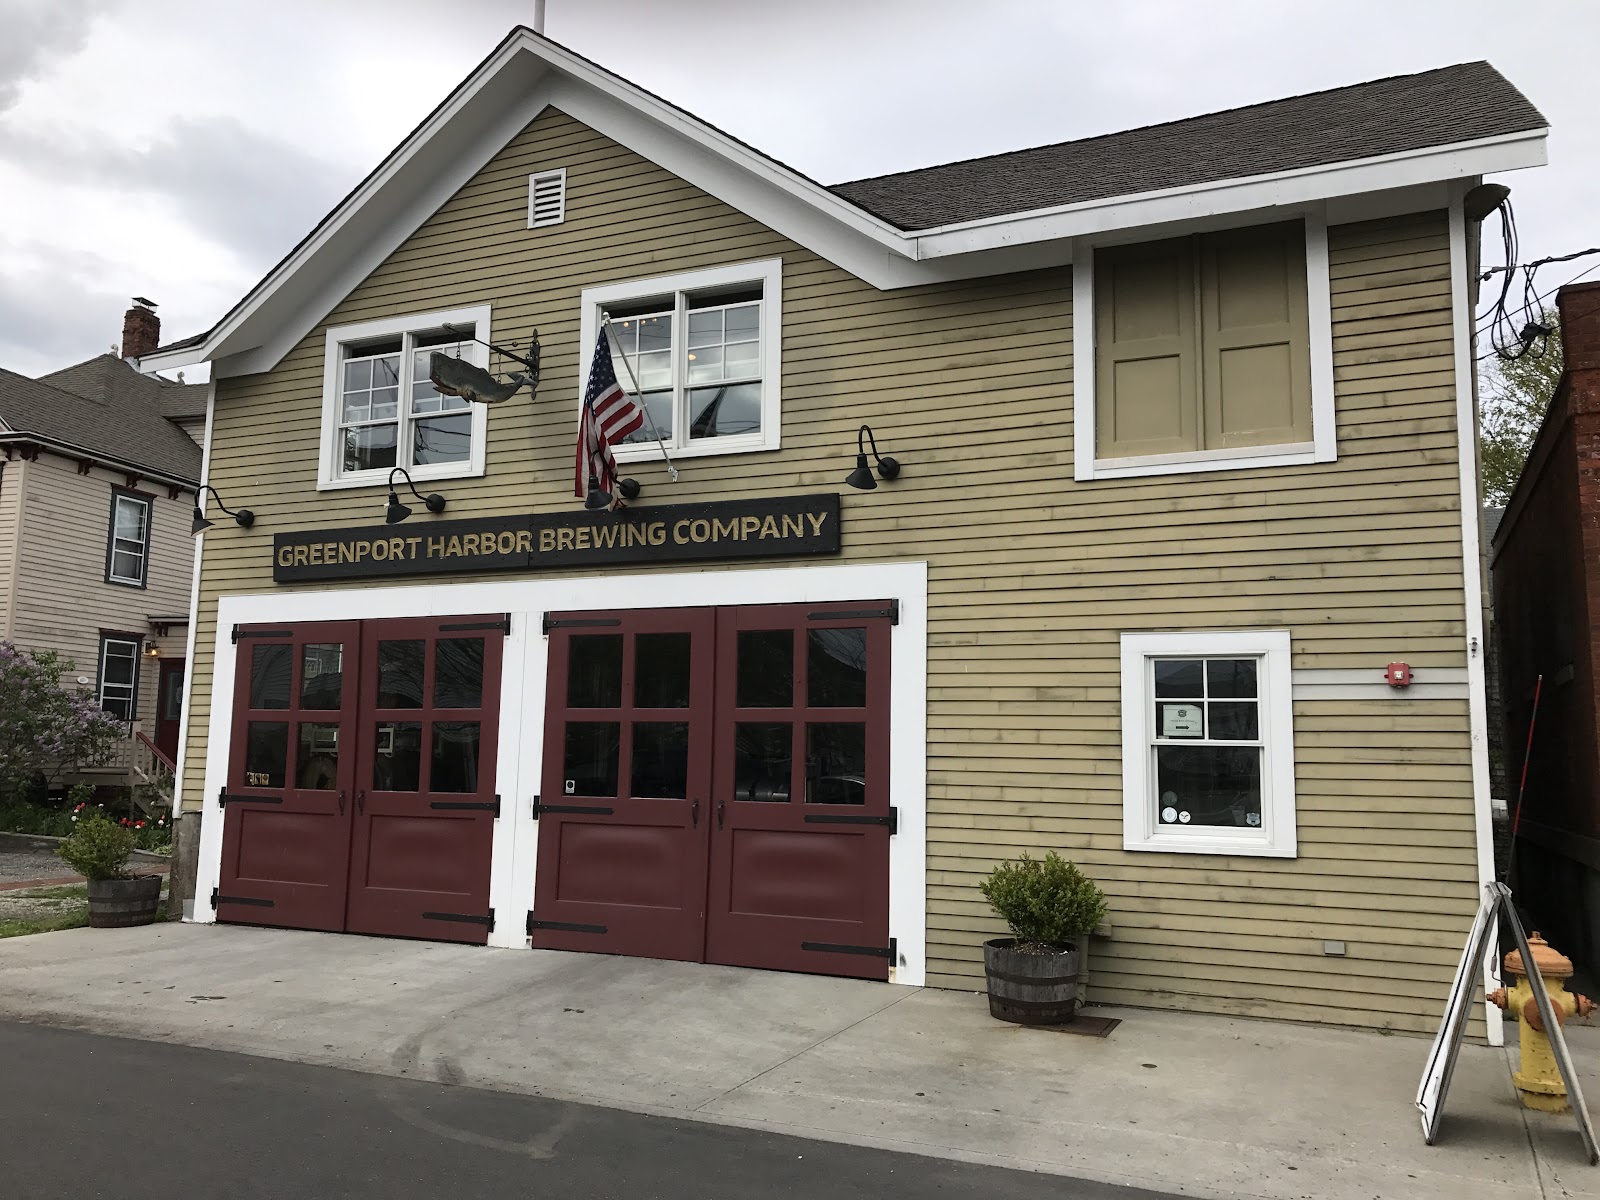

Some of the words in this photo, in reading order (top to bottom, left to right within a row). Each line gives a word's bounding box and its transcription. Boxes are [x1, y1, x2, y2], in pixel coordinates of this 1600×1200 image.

[277, 536, 422, 567] GREENPORT
[426, 530, 534, 559] HARBOR
[538, 521, 667, 553] BREWING
[672, 512, 828, 545] COMPANY
